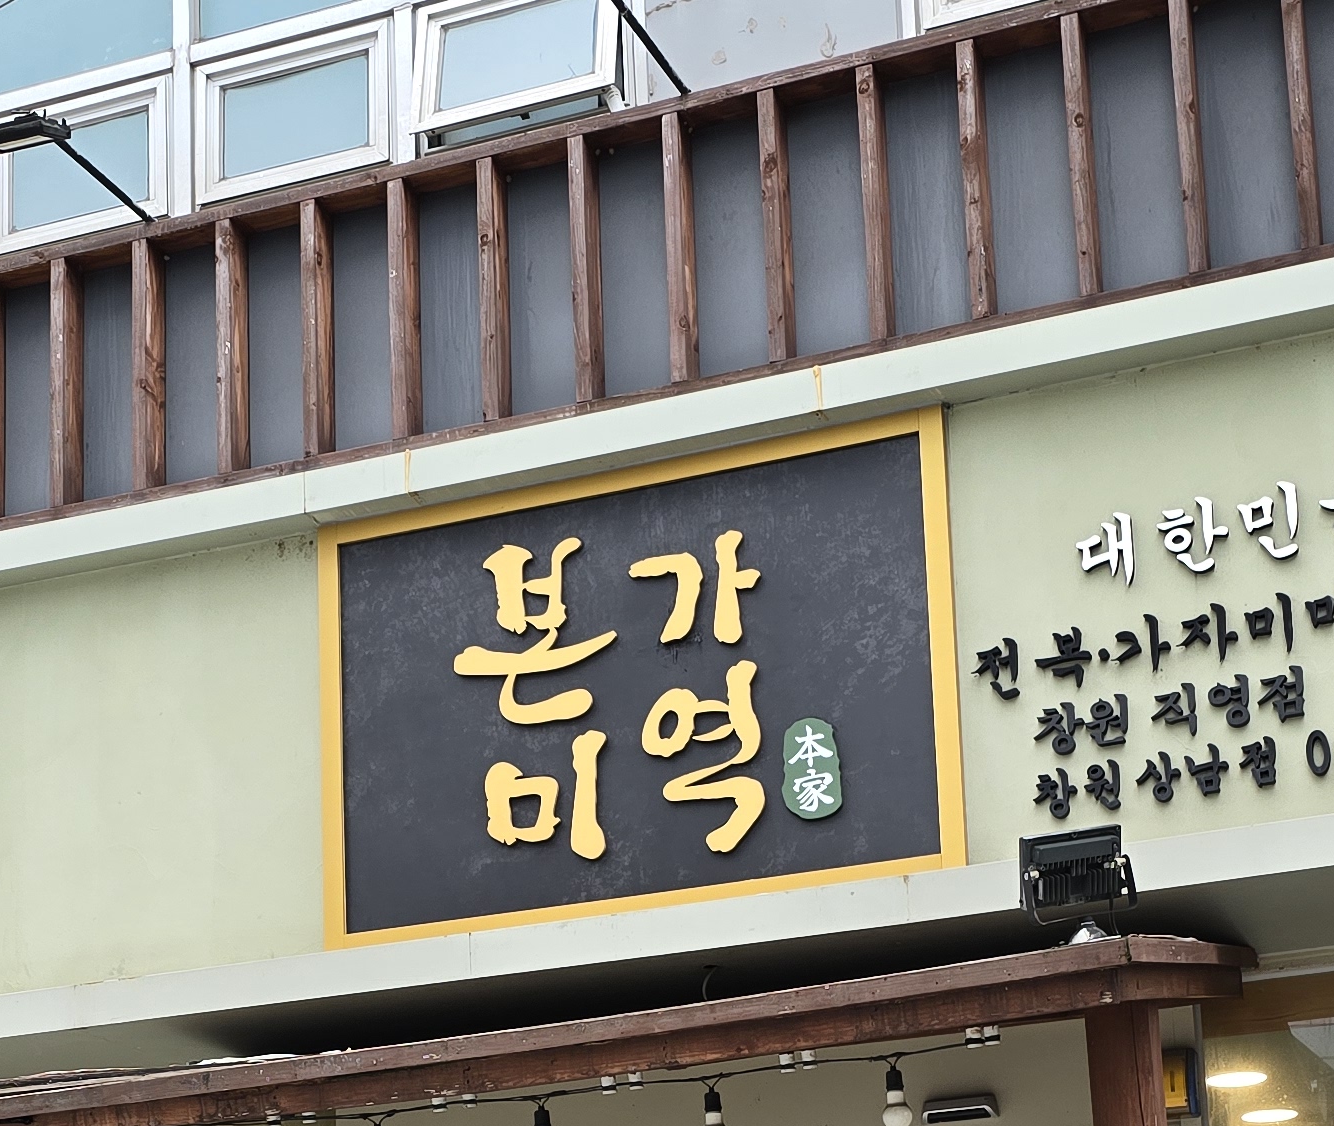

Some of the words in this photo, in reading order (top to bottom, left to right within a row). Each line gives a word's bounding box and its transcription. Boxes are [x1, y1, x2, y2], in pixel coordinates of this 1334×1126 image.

[453, 530, 762, 725] 본가
[1033, 692, 1129, 755] 창원
[1151, 666, 1307, 737] 직영점
[485, 660, 766, 860] 미역
[787, 724, 835, 813] 本家
[1033, 760, 1123, 819] 창원
[1135, 735, 1278, 805] 상남점
